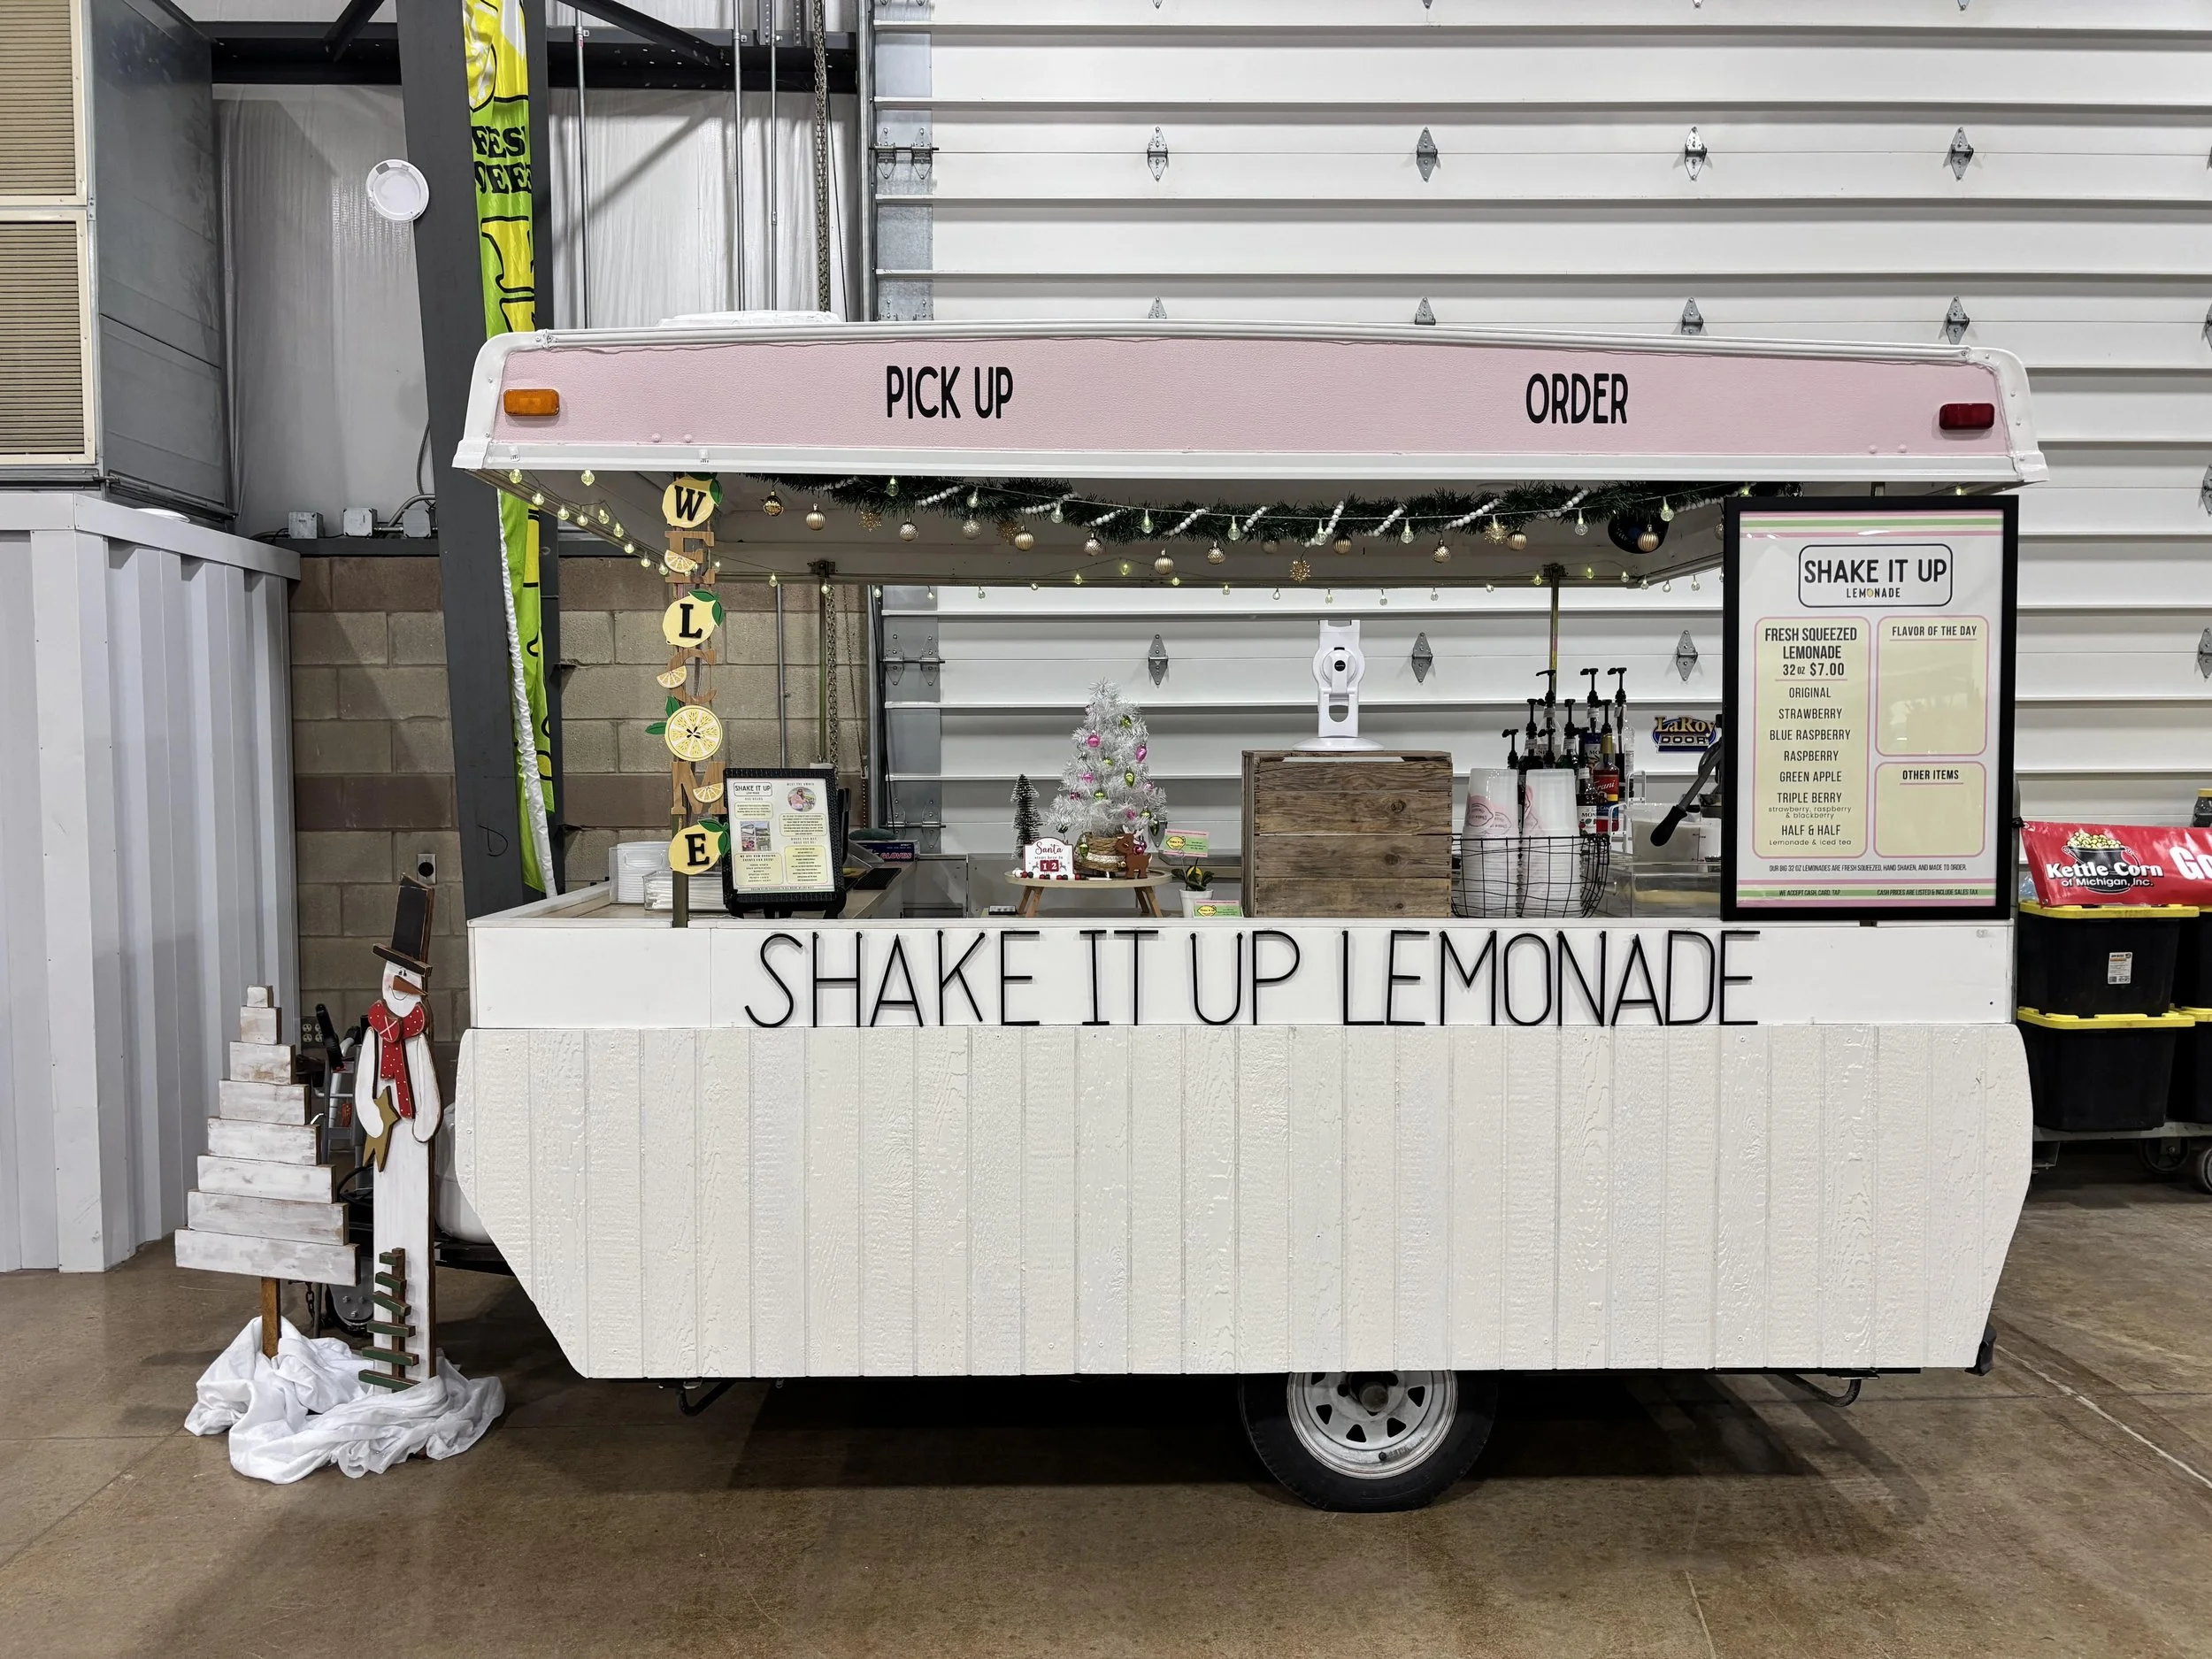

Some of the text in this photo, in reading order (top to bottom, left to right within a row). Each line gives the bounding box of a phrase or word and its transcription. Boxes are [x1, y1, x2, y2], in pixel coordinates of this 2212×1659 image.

[887, 365, 1014, 419] PICK UP
[1525, 373, 1629, 424] ORDER
[1804, 558, 1947, 583] SHAKE IT UP
[1764, 626, 1857, 642] FRESH SQUEEZED
[1892, 626, 1978, 636] FLAVOR OF THE DAY
[1783, 645, 1842, 659] LEMONADE
[1783, 664, 1796, 676] 32
[1809, 662, 1845, 677] $7.00
[1788, 687, 1832, 698] ORIGINAL
[1778, 708, 1842, 719] STRAWBERRY
[1654, 716, 1717, 738] LaRoy
[1770, 729, 1851, 741] BLUE RASPBERRY
[1784, 750, 1839, 762] RASPBERRY
[1779, 771, 1842, 782] GREEN APPLE
[1902, 770, 1959, 780] OTHER ITEMS
[1777, 792, 1842, 803] TRIPLE BERRY
[1781, 825, 1841, 835] HALF & HALF
[1035, 841, 1064, 855] Santa
[2045, 862, 2163, 879] Kettle Corn
[2061, 877, 2154, 887] of Michigan, Inc.
[744, 929, 1762, 1027] SHAKE IT UP LEMONADE
